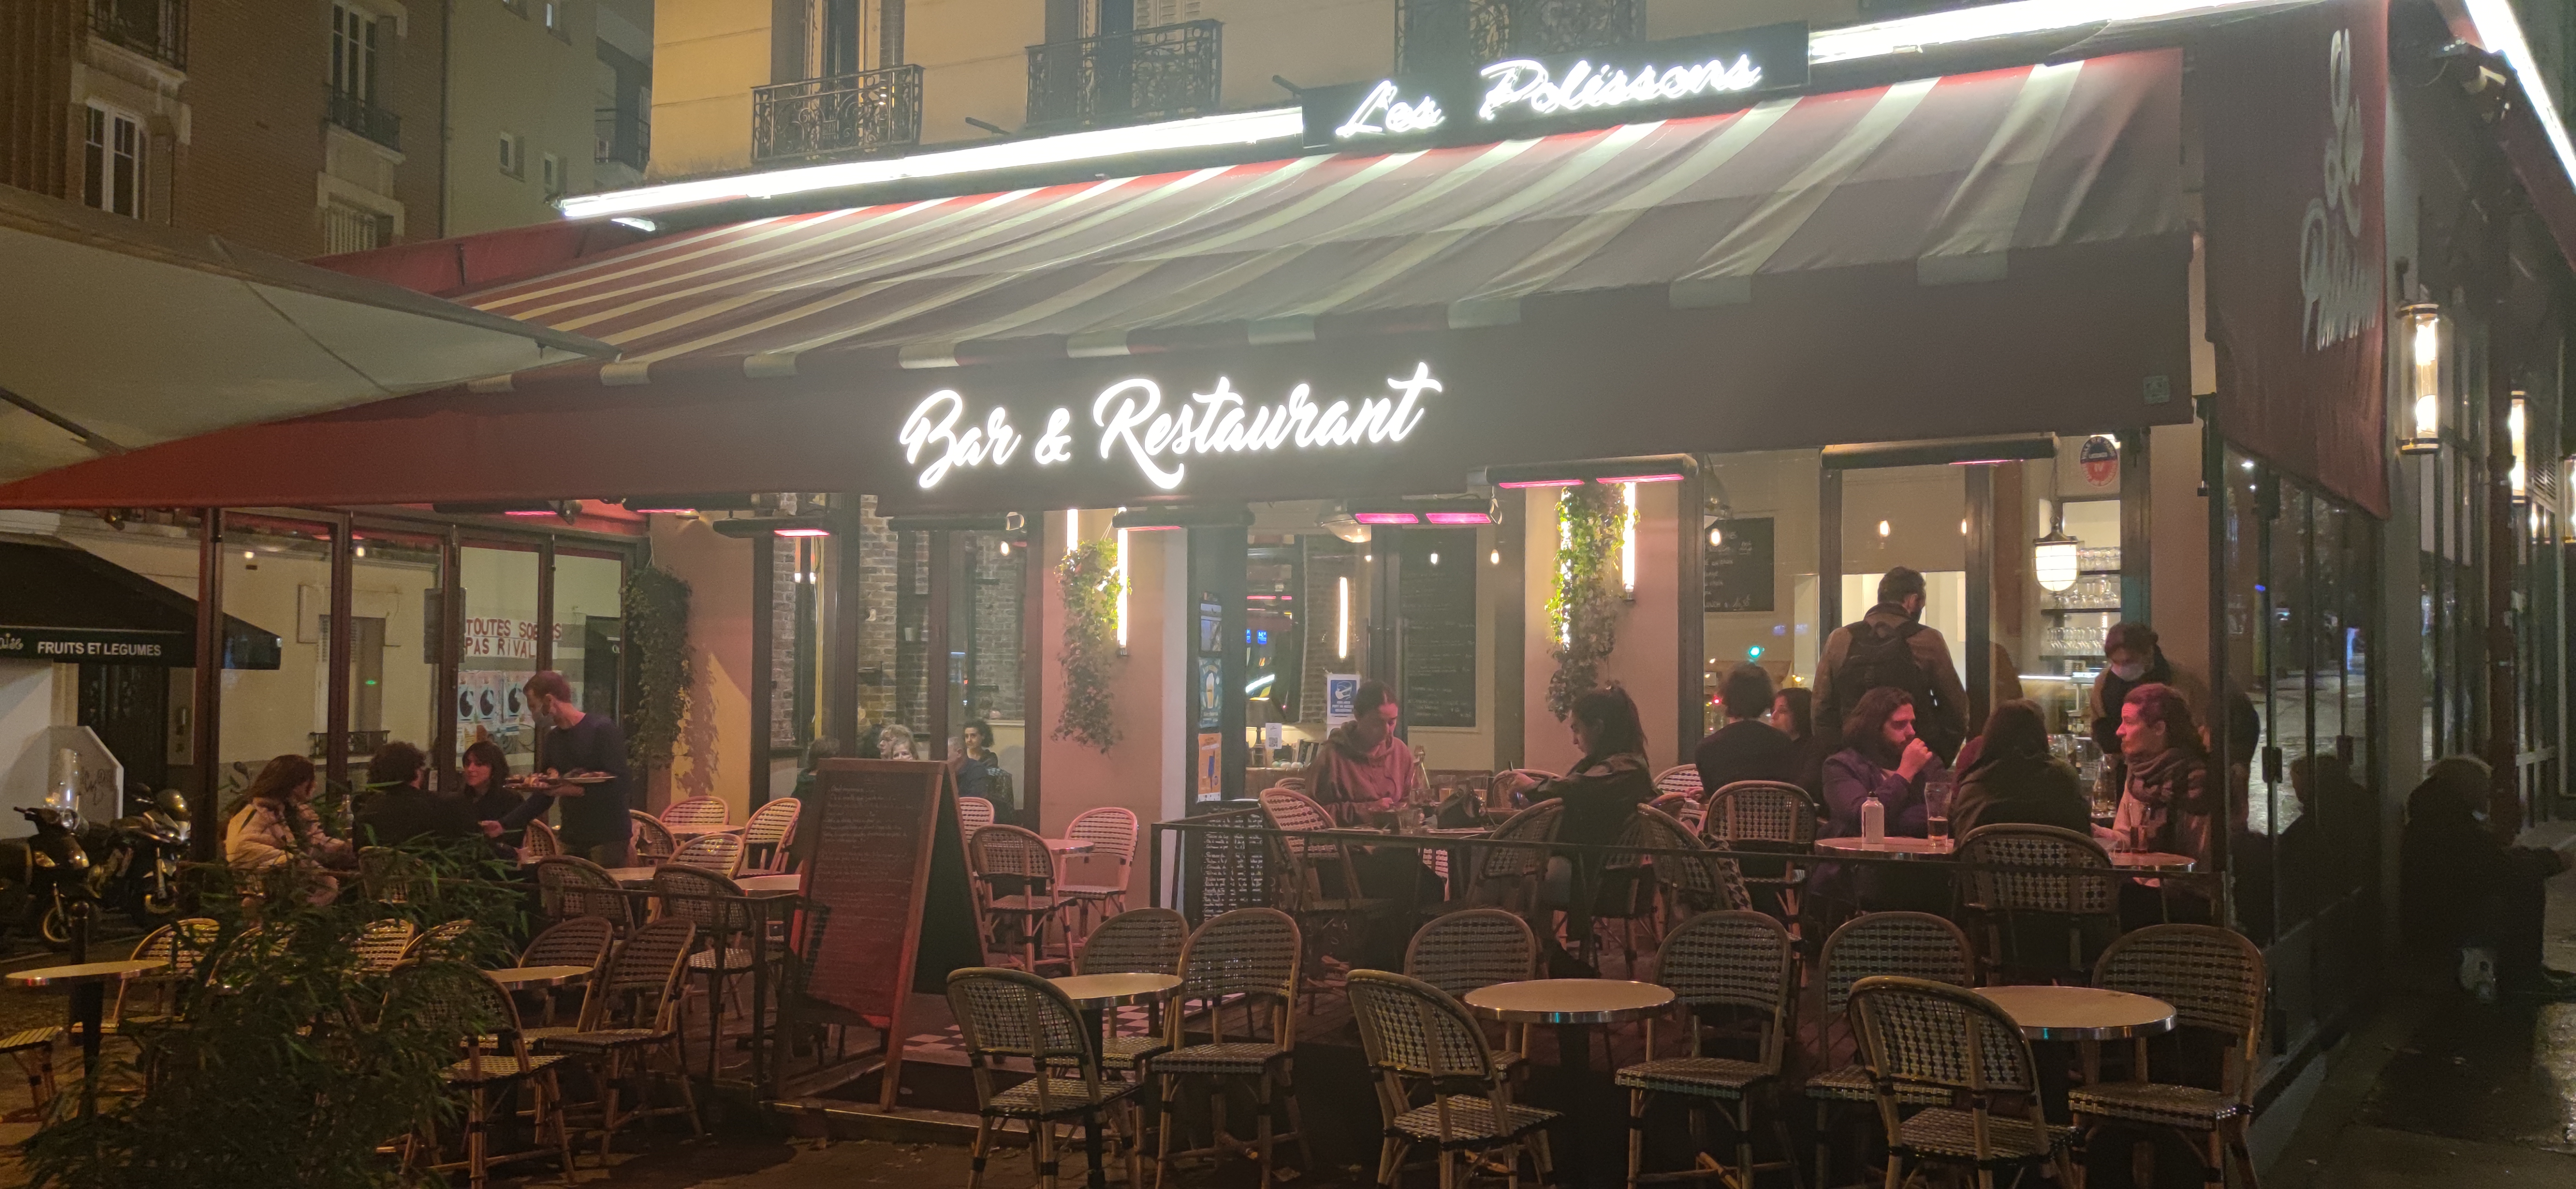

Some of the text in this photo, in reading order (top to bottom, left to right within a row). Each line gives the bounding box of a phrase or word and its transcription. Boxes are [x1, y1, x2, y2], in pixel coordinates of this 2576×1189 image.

[1335, 54, 1763, 138] Les Polissons
[899, 361, 1442, 489] Bar & Restaurant
[466, 618, 561, 640] TOUTES SOES
[38, 641, 84, 654] FRUITS
[88, 643, 101, 655] ET
[104, 643, 161, 656] LEGUMES
[466, 637, 489, 655] PAS
